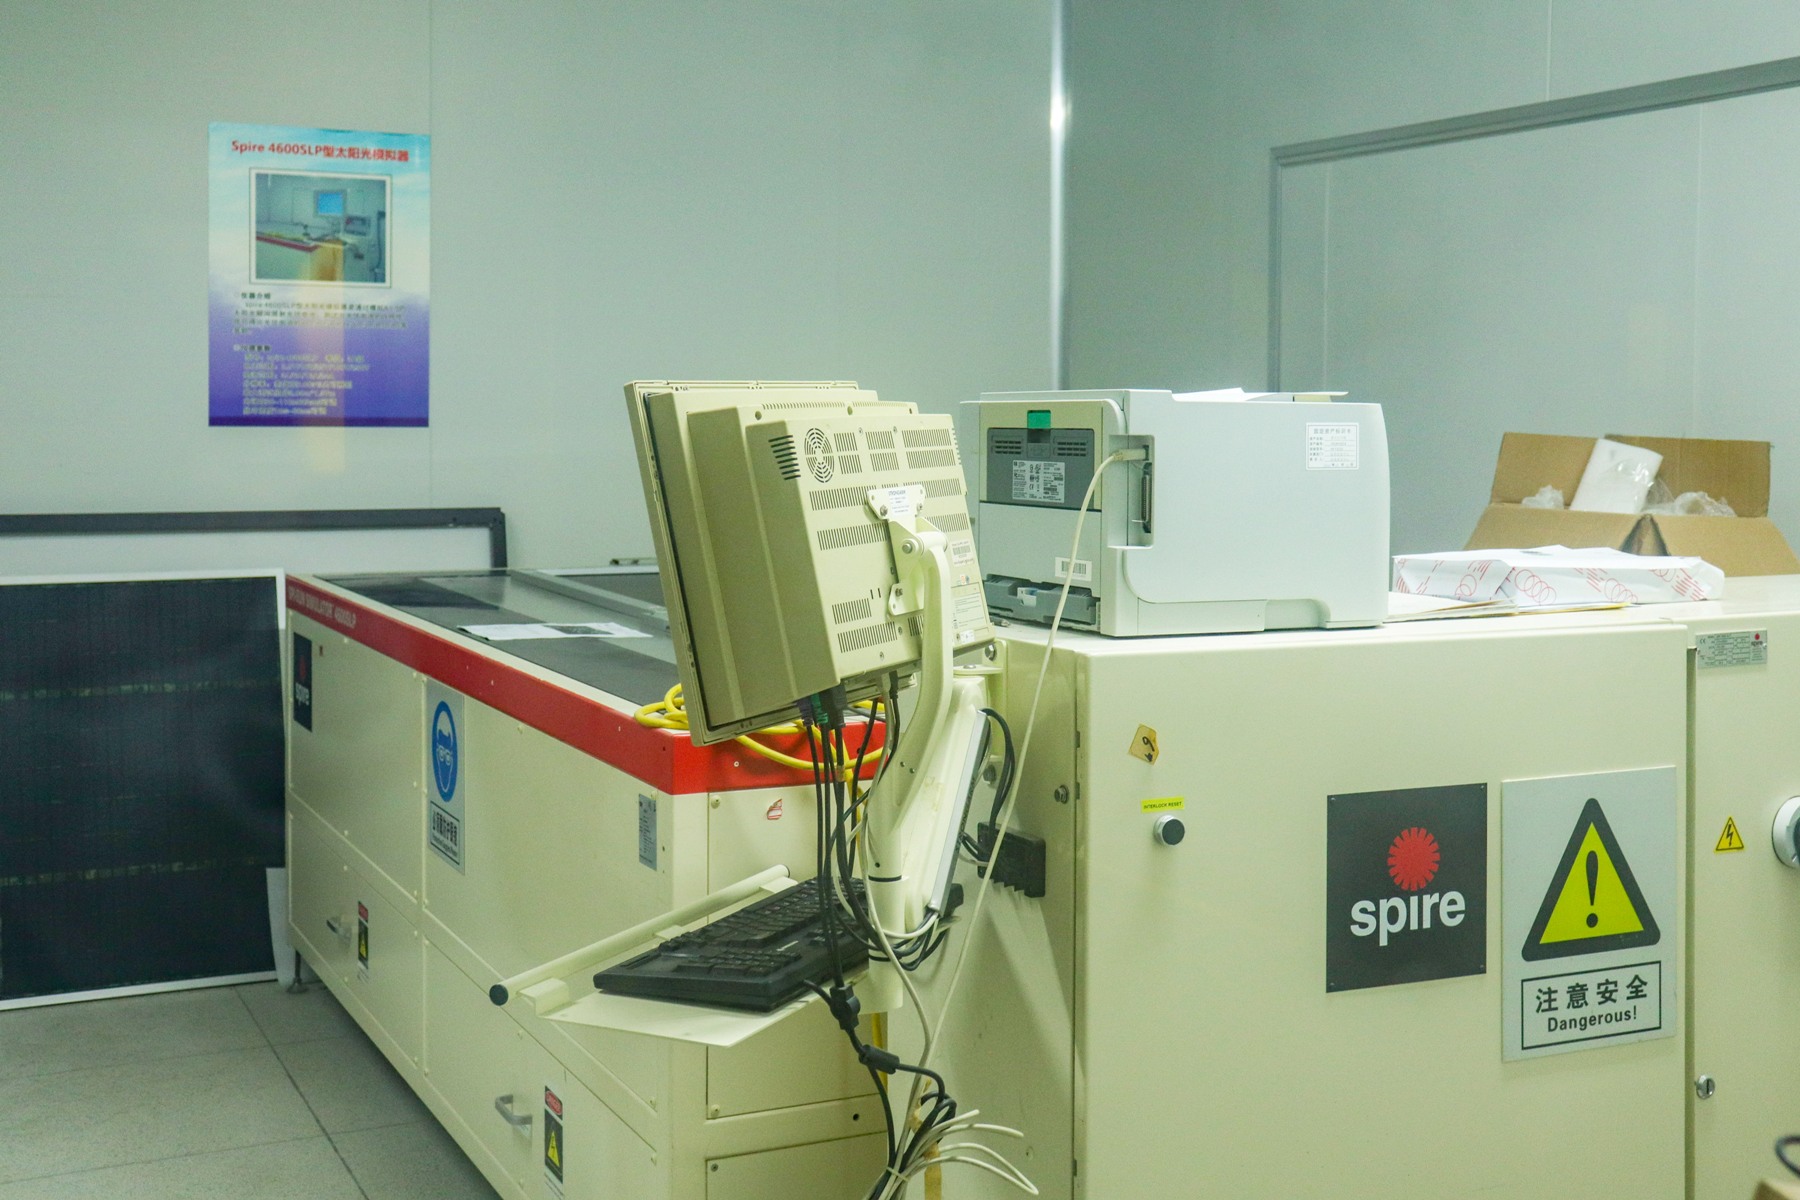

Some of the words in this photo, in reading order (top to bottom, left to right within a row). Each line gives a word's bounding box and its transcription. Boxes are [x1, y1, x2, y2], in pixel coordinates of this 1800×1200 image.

[231, 140, 265, 154] Spire
[1350, 891, 1465, 946] spire
[1535, 974, 1648, 1013] 注意安全
[1547, 1005, 1637, 1032] Dangerous!
